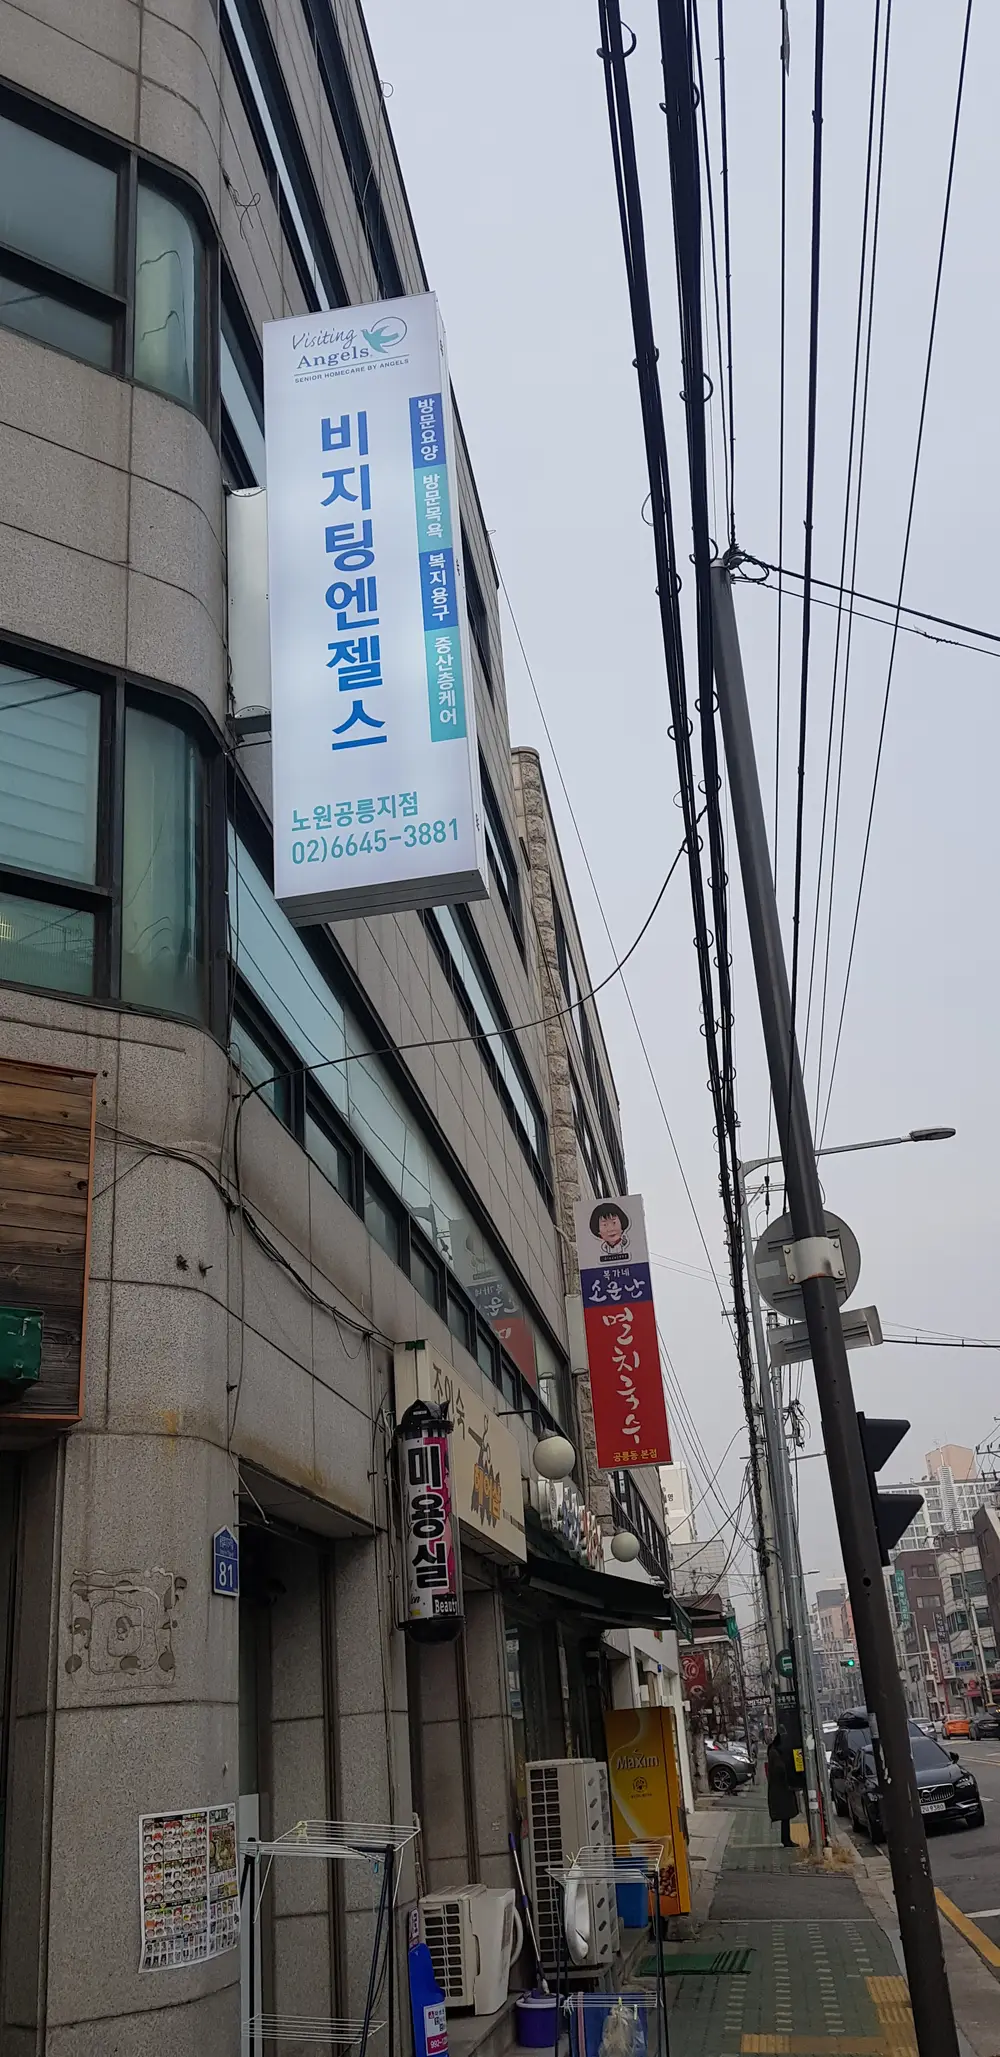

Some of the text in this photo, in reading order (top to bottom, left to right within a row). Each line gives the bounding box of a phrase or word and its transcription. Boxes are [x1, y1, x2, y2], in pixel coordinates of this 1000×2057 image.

[292, 328, 358, 350] Visiting
[296, 346, 370, 370] Angels
[294, 358, 410, 384] SENIOR HOMECARE BY ANGELS
[417, 397, 439, 462] 방문요양
[422, 473, 443, 539] 방문목욕
[320, 410, 388, 751] 비지팅엔젤스
[428, 552, 451, 622] 복지용구
[433, 635, 458, 726] 중산층케어
[291, 791, 419, 832] 노원공릉지점
[291, 818, 459, 865] 02)6645-3881
[588, 1278, 646, 1303] 소문난
[602, 1306, 642, 1445] 멸치국수
[612, 1447, 658, 1463] 공릉동 본점
[407, 1445, 449, 1590] 미용실
[218, 1561, 234, 1588] 81
[434, 1598, 458, 1616] Beauty
[616, 1754, 661, 1770] Maxim
